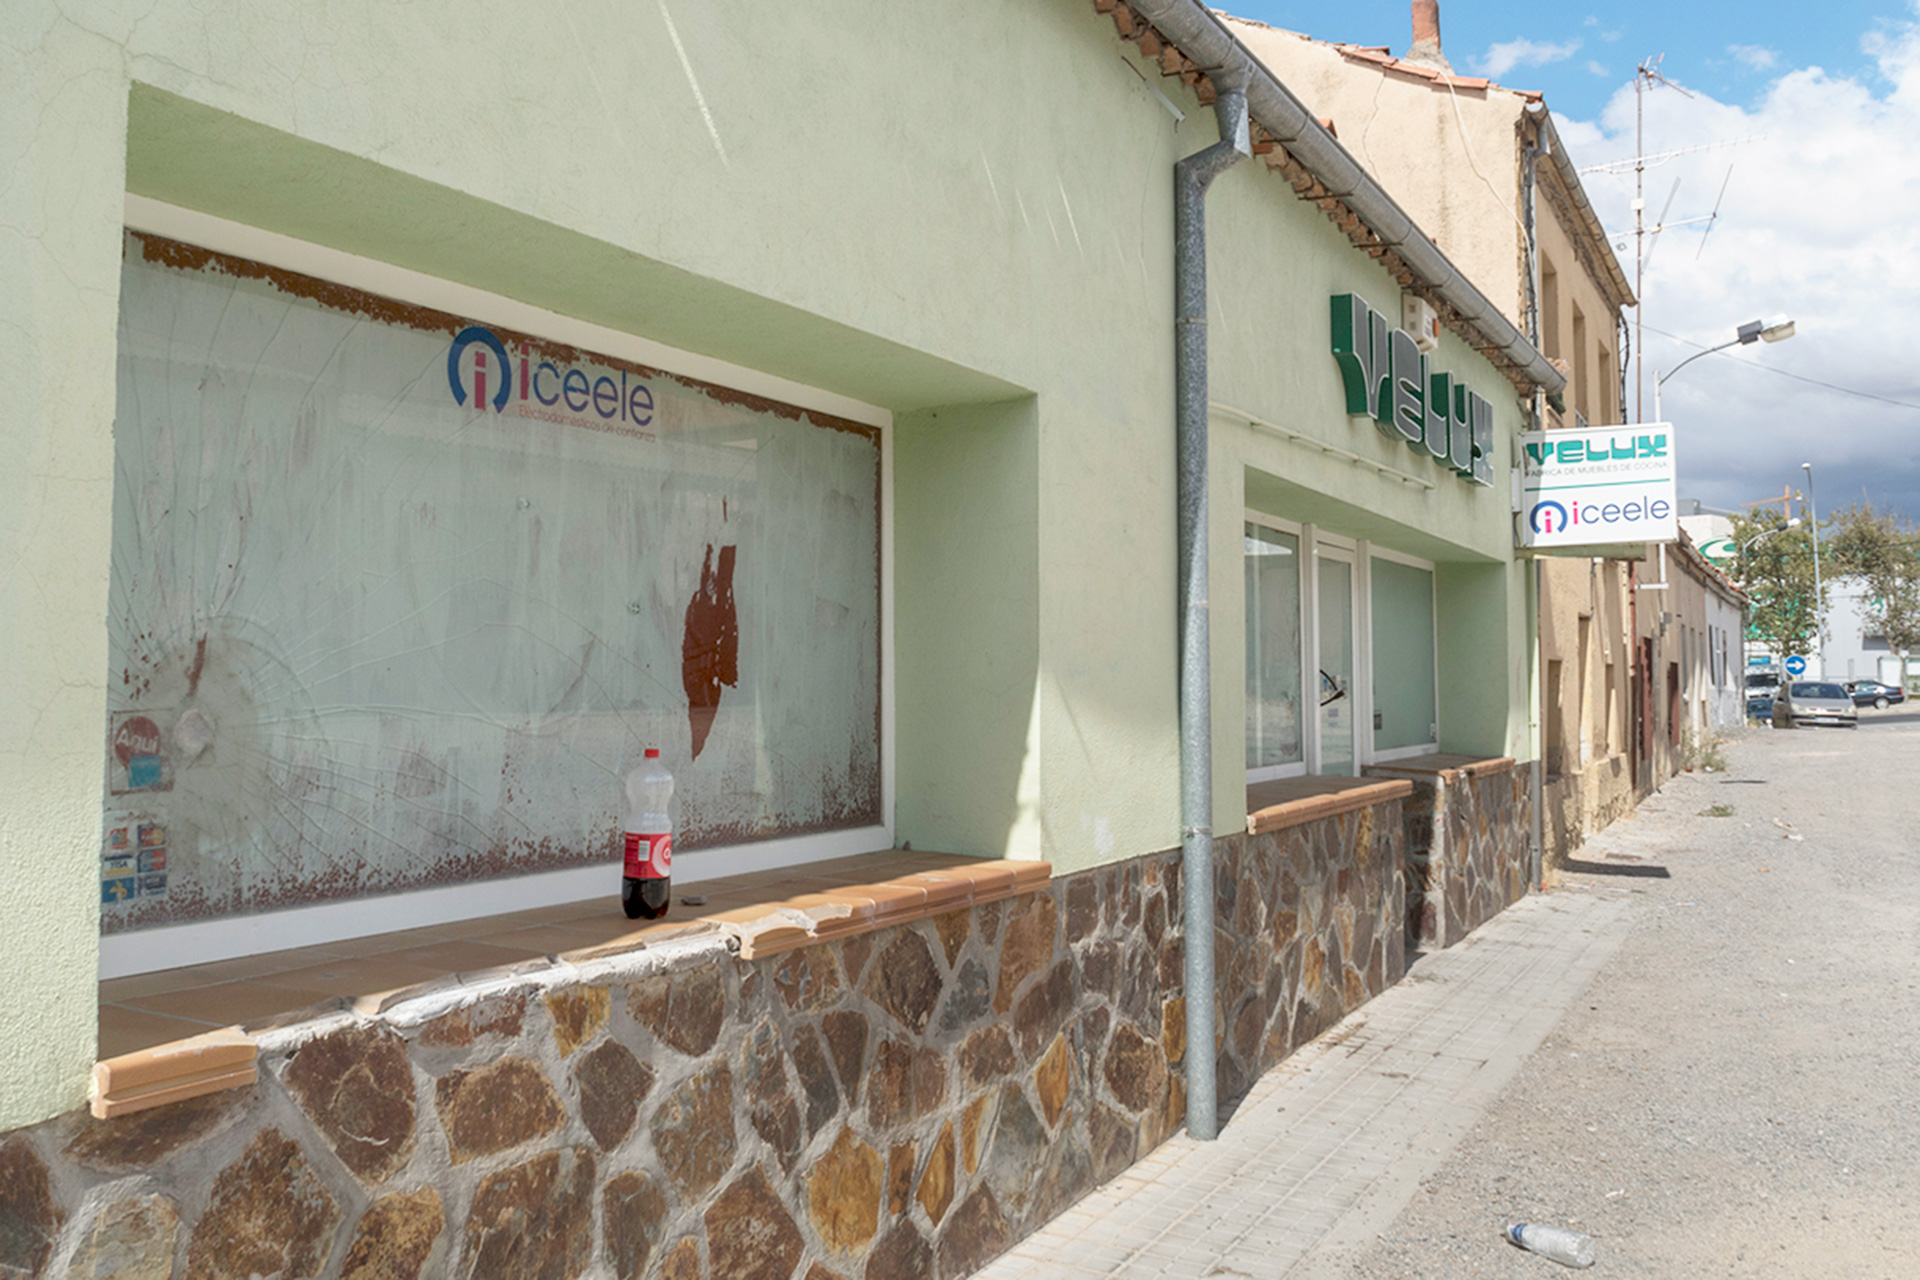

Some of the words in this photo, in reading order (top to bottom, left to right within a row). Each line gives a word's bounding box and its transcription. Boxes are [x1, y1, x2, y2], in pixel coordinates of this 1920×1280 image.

[520, 343, 654, 426] iceele
[1526, 434, 1667, 466] VELUX
[1564, 467, 1575, 475] DE
[1578, 464, 1618, 474] MUEBLES
[1620, 463, 1631, 471] DE
[1634, 461, 1667, 471] COCINA
[1573, 495, 1670, 525] iceele
